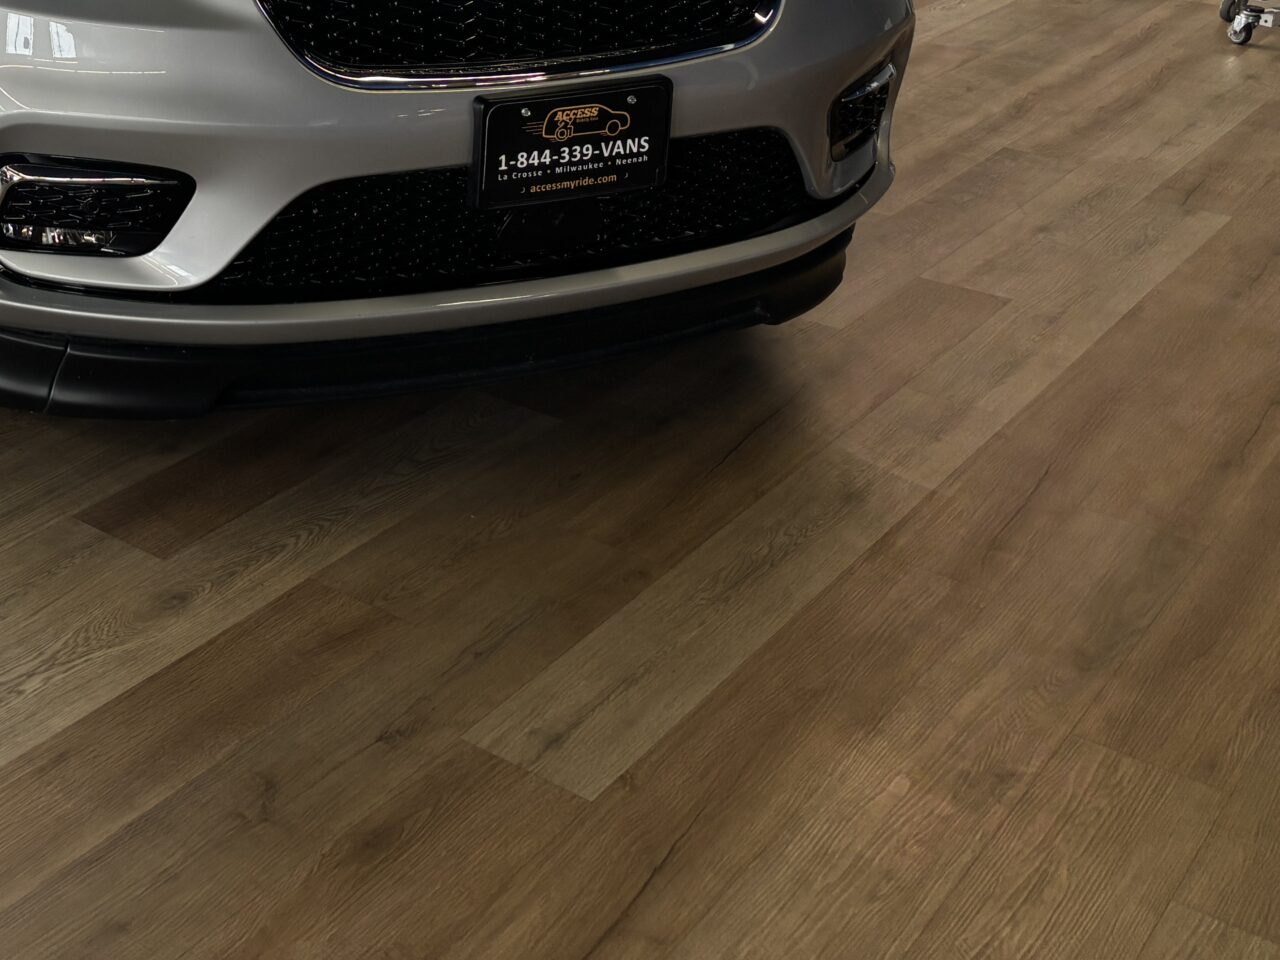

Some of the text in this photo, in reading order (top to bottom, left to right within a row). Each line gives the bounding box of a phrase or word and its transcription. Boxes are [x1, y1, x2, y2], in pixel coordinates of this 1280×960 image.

[554, 107, 599, 121] ACCESS
[498, 136, 650, 171] 1-844-339-VANS
[498, 155, 648, 181] La Crosse Milwaukee Neenah
[530, 173, 617, 193] accessmyride.com
